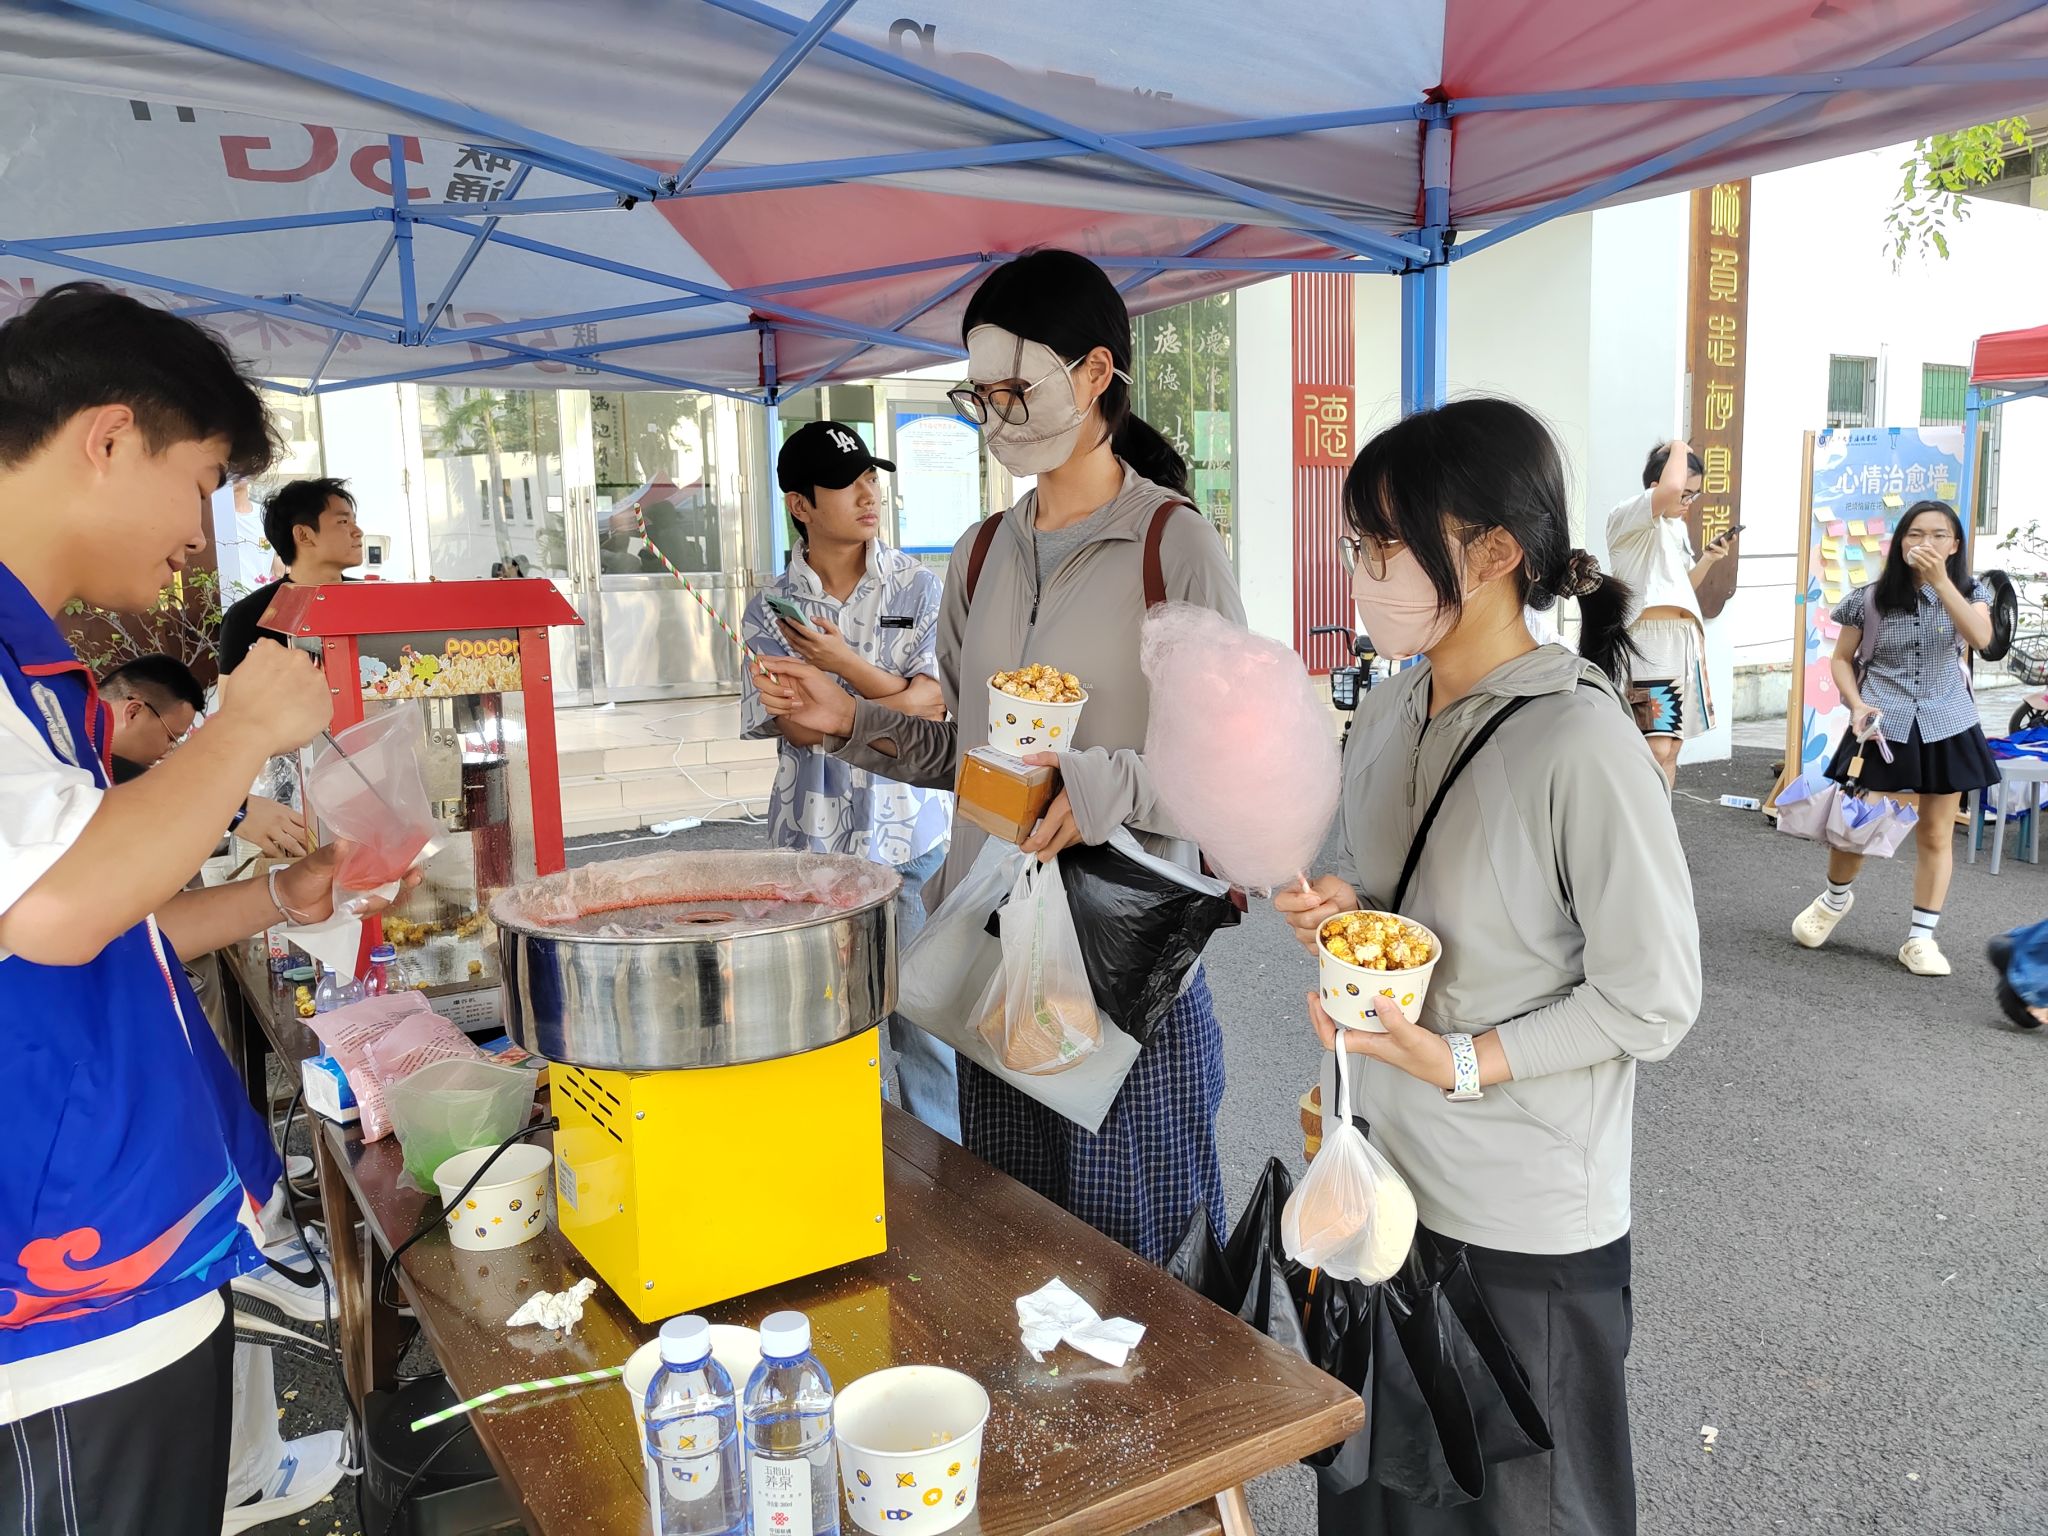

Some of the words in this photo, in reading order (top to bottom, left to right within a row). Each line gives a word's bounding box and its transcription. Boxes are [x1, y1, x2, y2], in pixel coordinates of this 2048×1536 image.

[1153, 321, 1182, 354] 德
[1157, 364, 1181, 391] 德
[826, 429, 859, 453] LA
[1304, 394, 1348, 458] 德
[1836, 463, 1949, 494] 心情治愈墙
